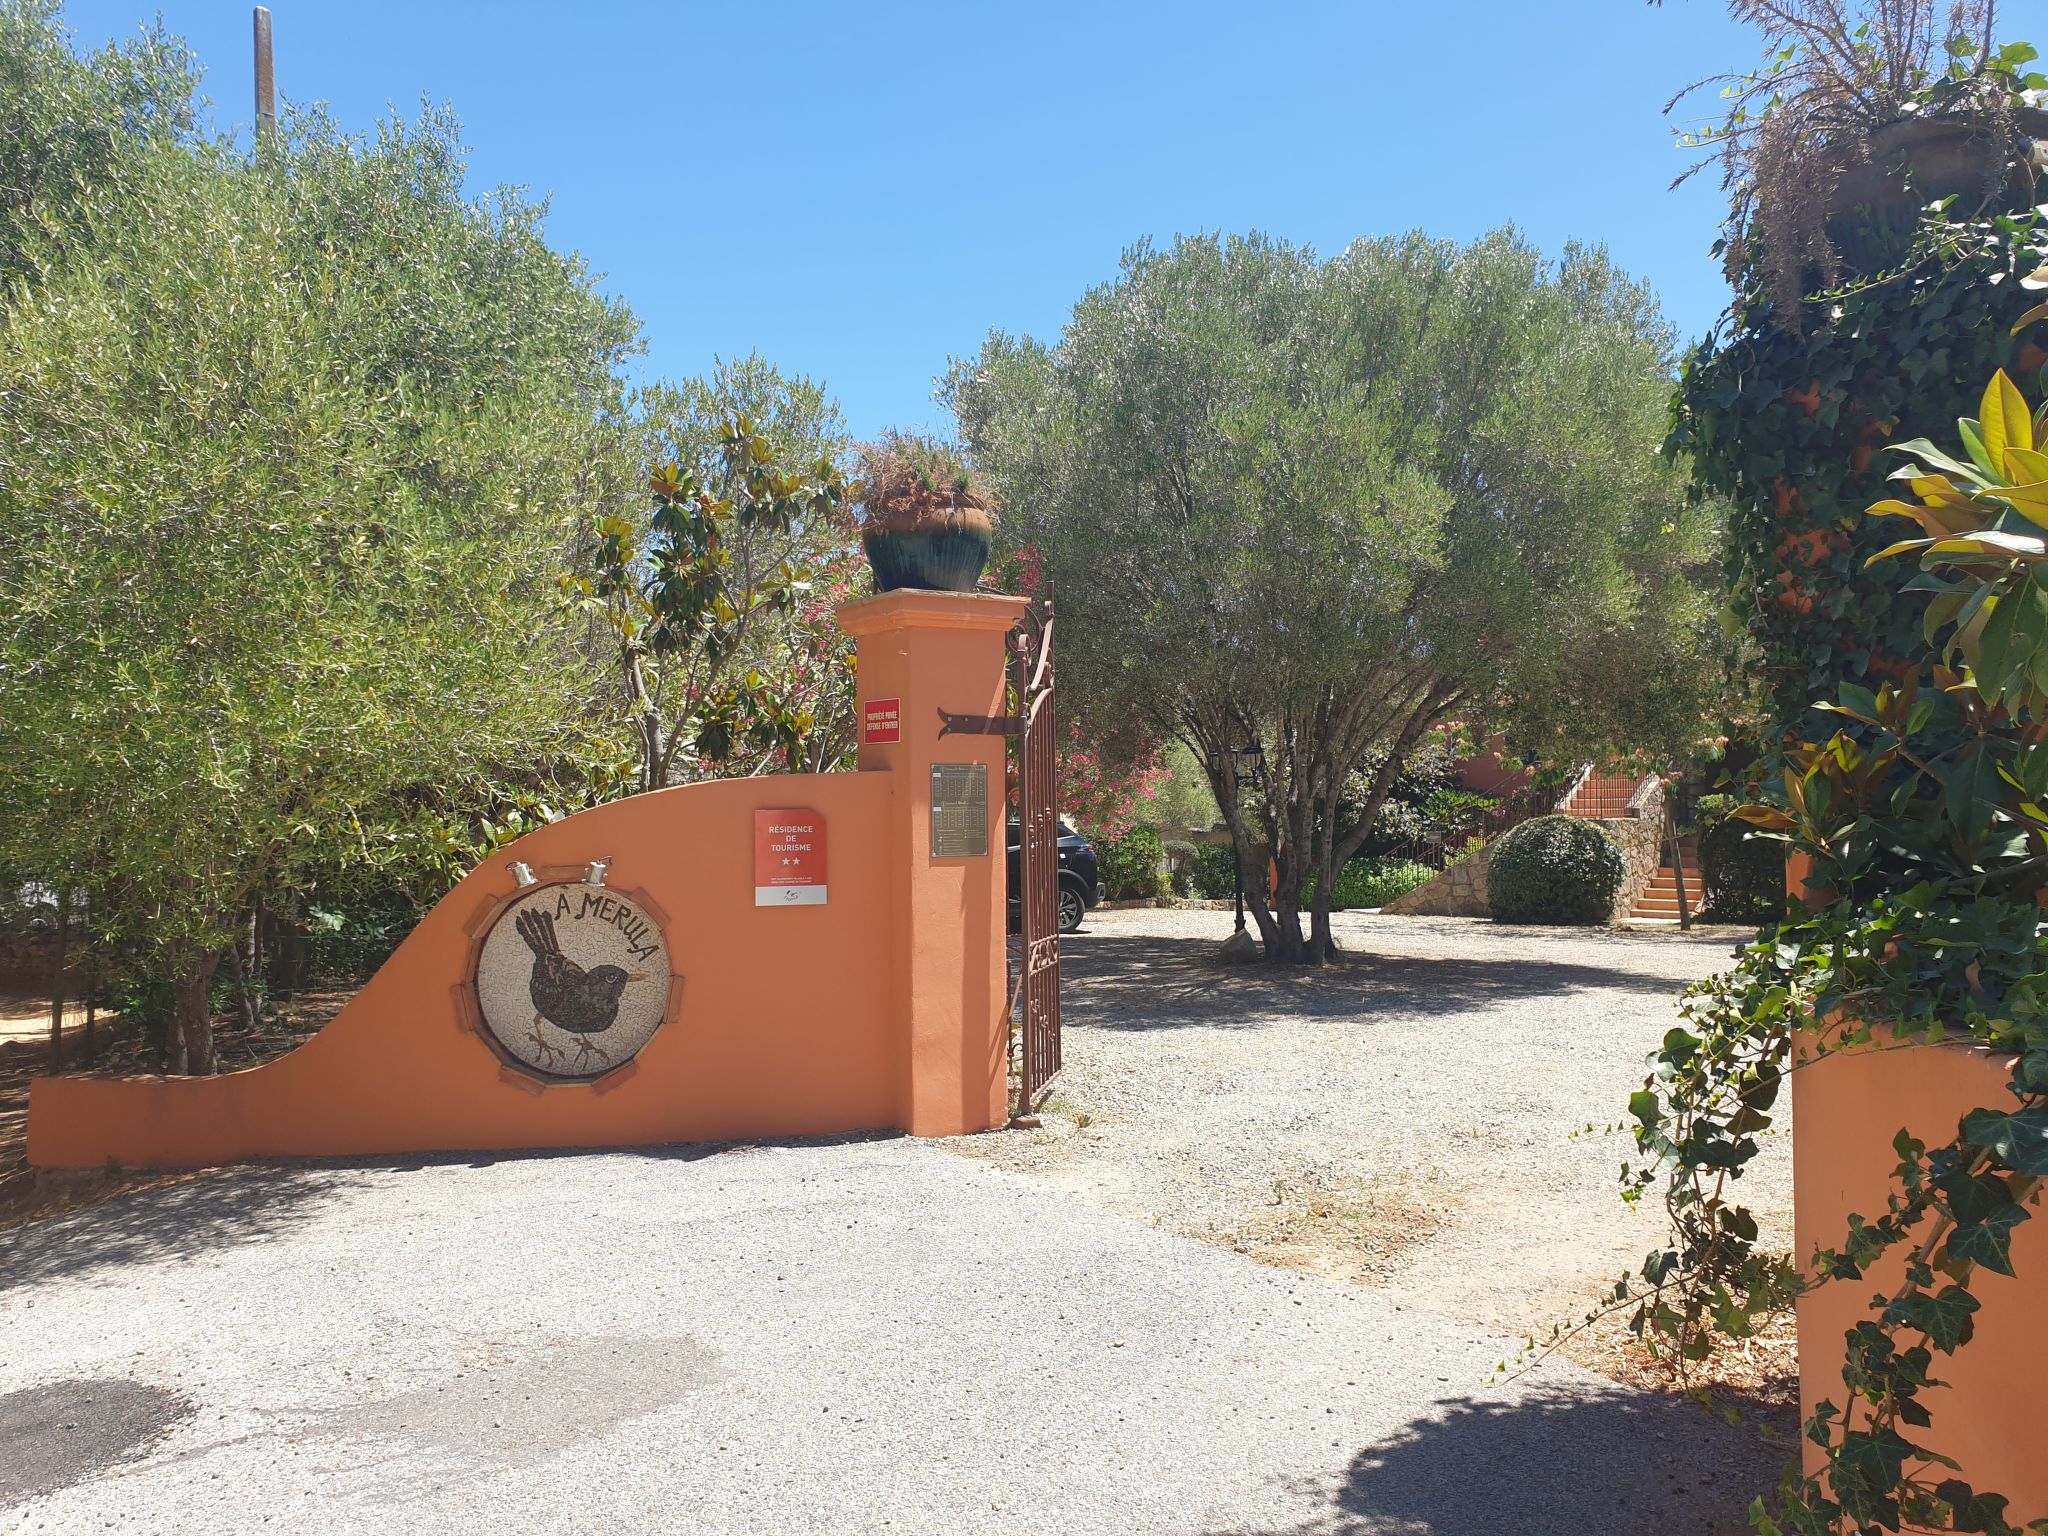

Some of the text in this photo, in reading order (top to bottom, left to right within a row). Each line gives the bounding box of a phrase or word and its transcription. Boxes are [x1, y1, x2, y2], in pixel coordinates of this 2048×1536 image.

[769, 824, 813, 833] RÉSIDENCE
[771, 844, 811, 852] TOURISME
[554, 892, 660, 963] A MERULA
